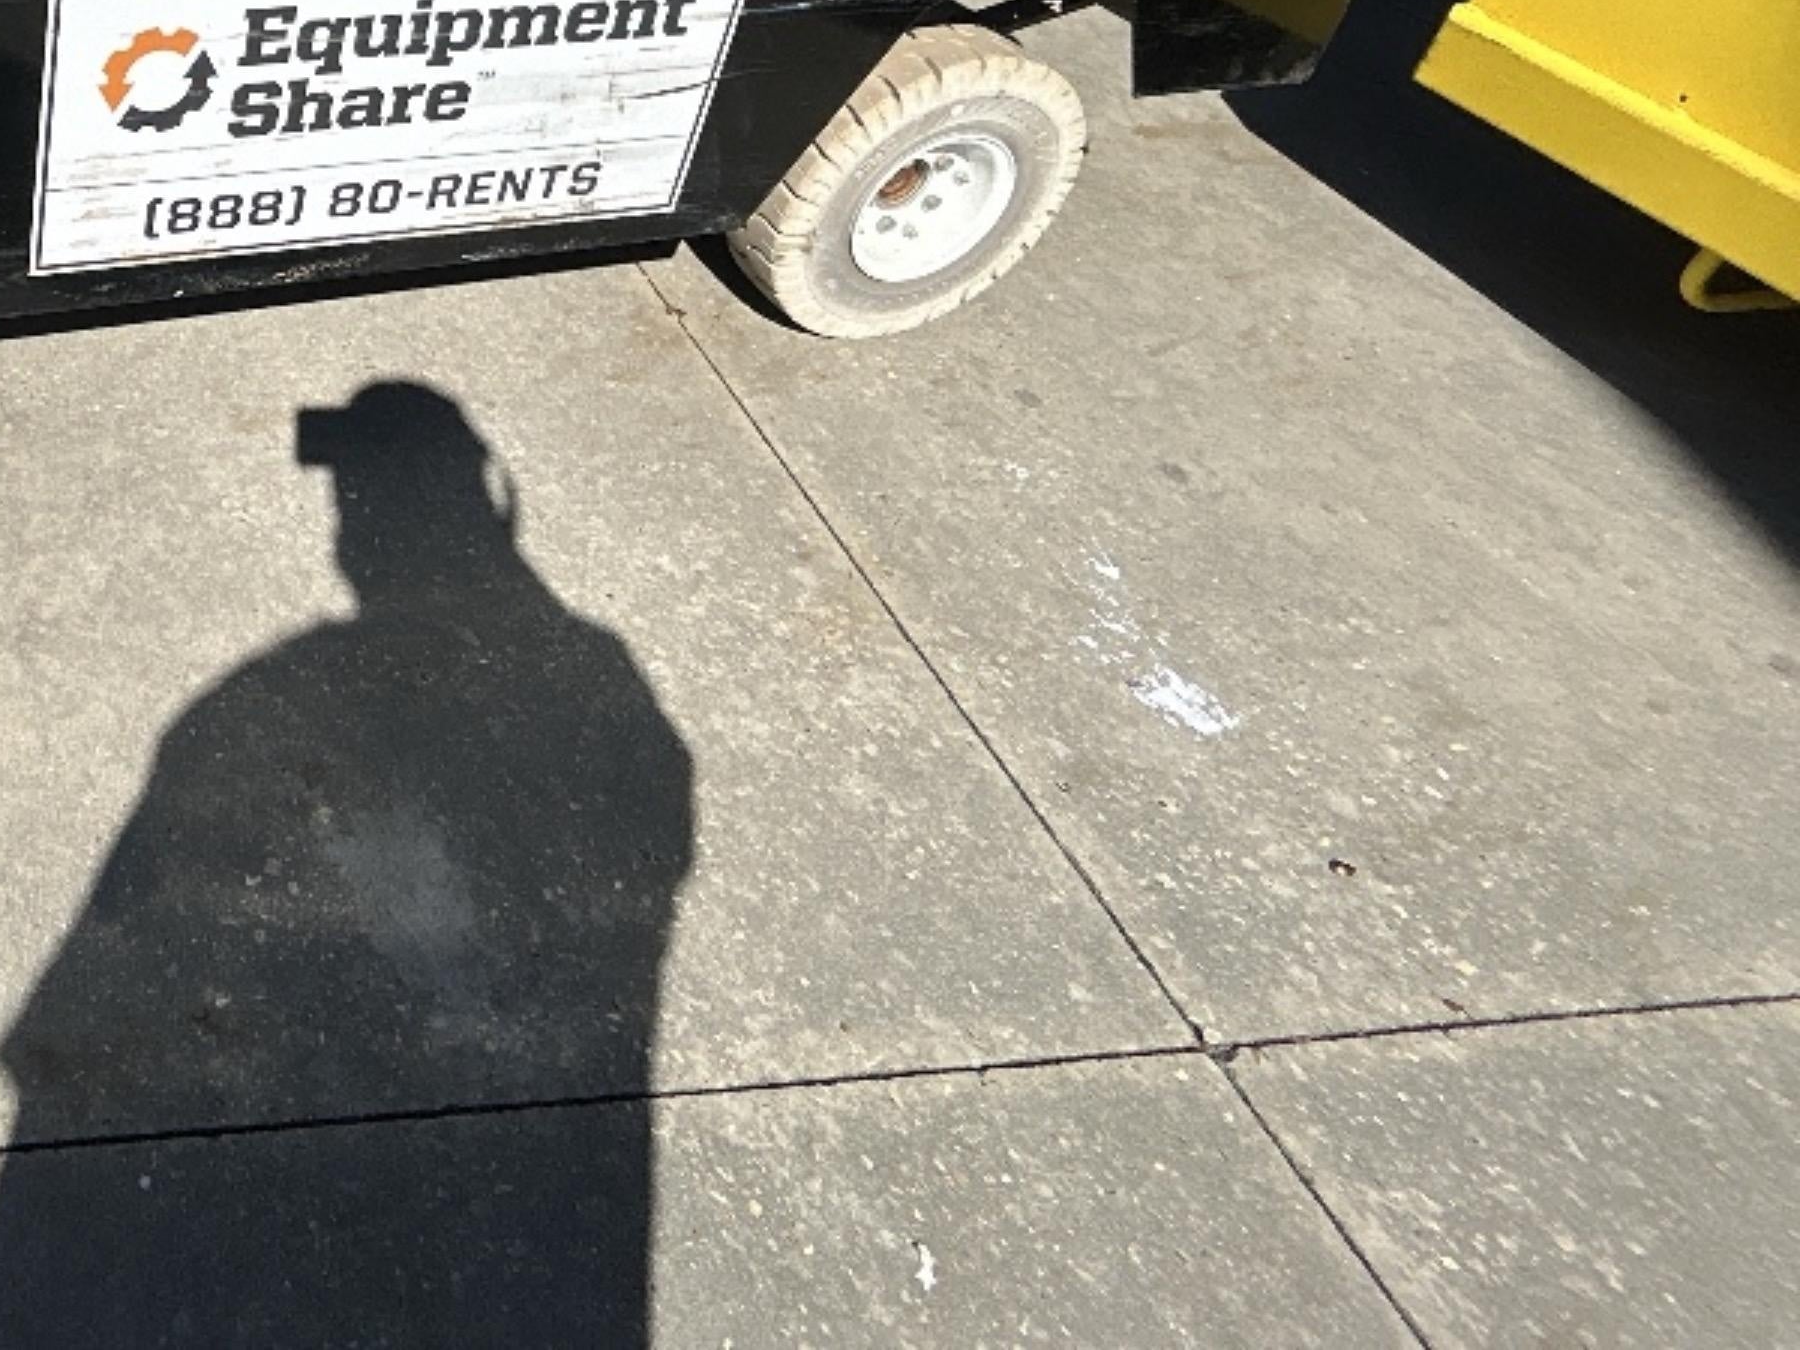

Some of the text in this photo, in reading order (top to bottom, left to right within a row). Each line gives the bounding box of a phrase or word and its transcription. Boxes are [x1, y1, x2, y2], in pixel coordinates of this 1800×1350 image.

[226, 77, 471, 139] Share
[142, 161, 603, 240] (888) 80-RENTS
